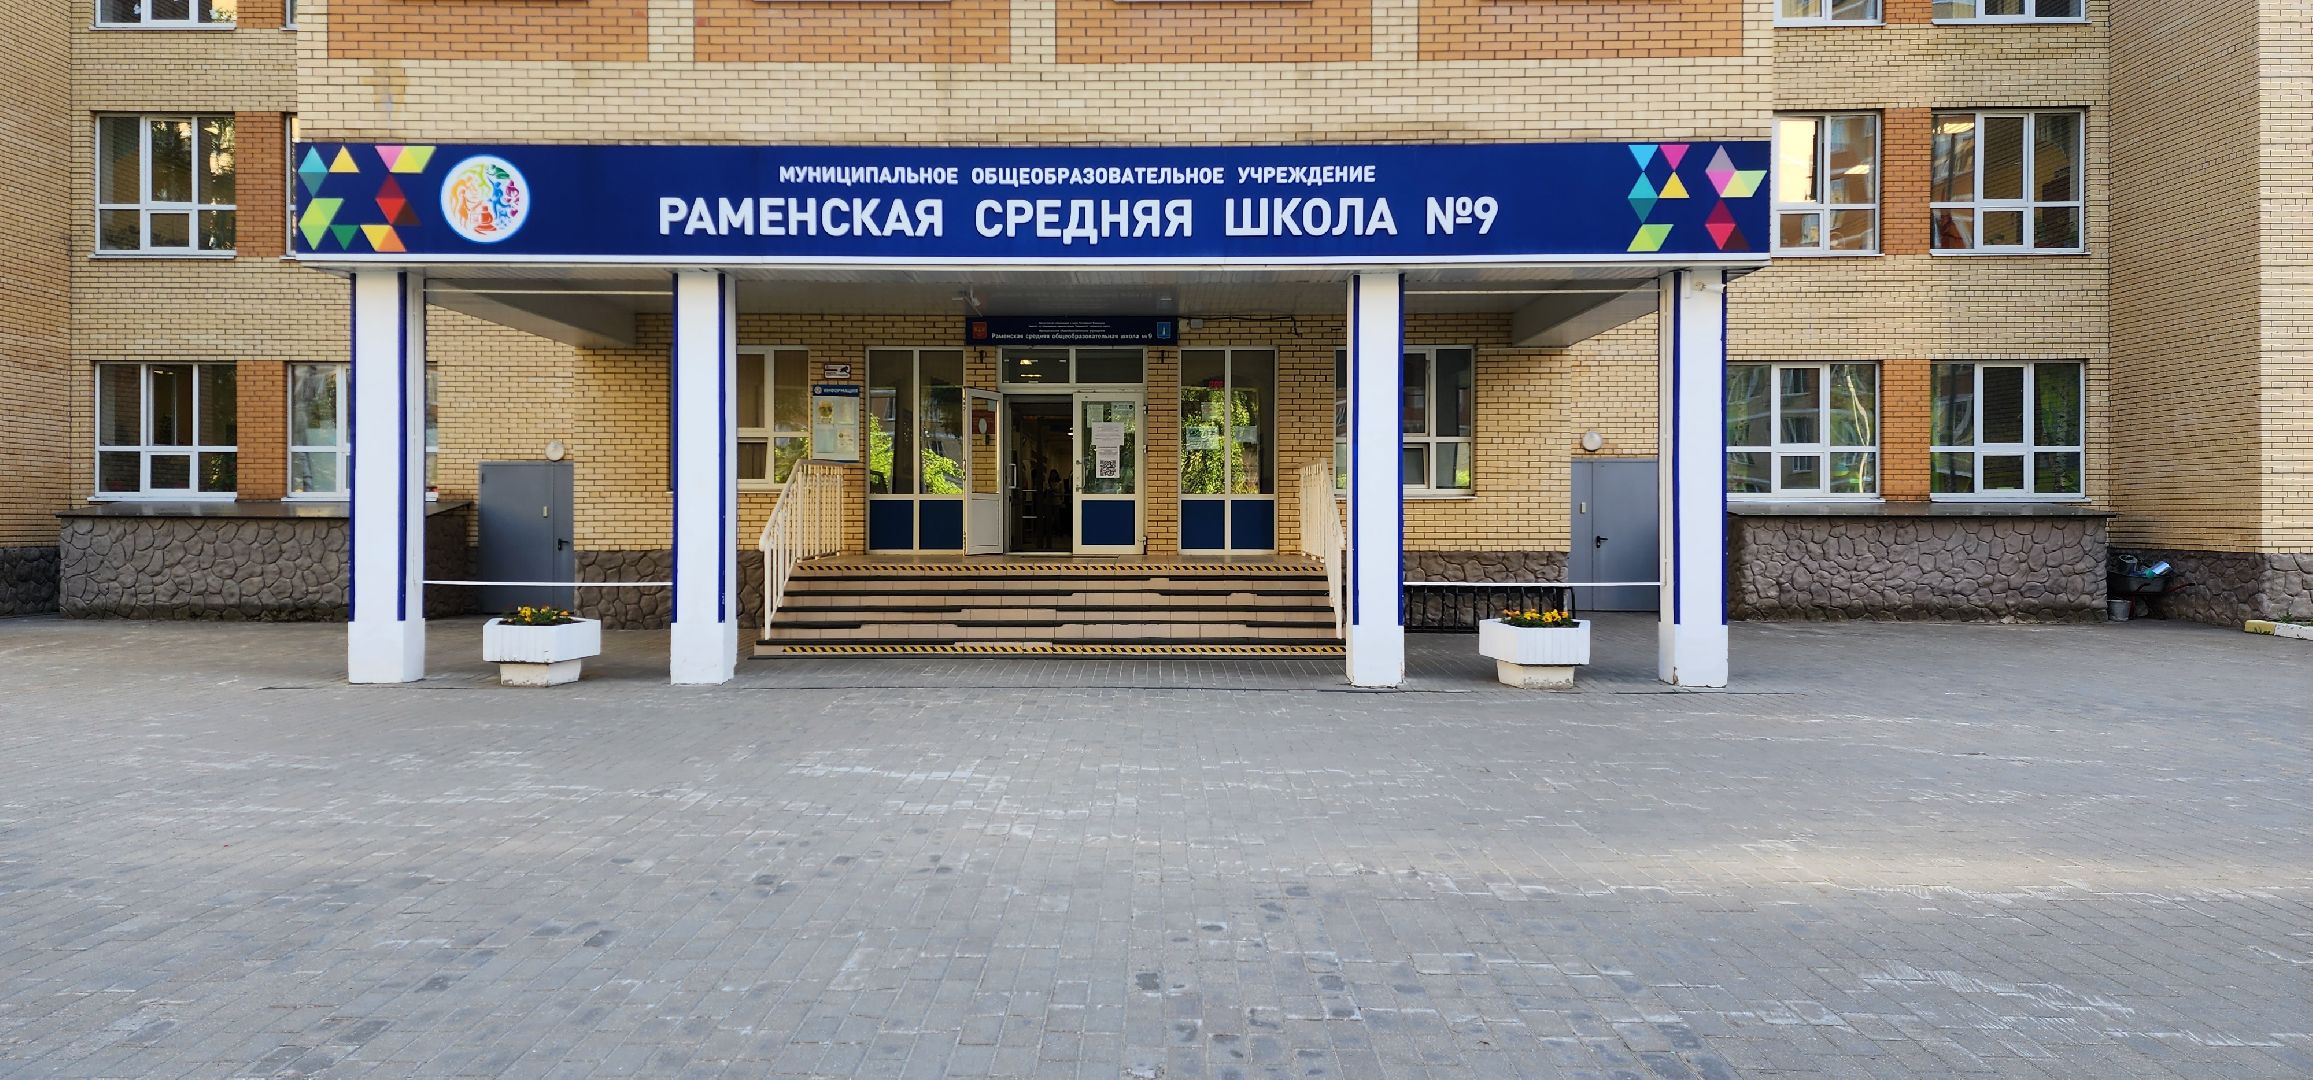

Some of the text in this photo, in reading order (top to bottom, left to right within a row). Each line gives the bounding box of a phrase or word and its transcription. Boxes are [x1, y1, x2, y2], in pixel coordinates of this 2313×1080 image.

[779, 165, 1376, 188] МУНИЦИПАЛЬНОЕ ОБЩЕОБРАЗОВАТЕЛЬНОЕ УЧРЕЖДЕНИЕ
[659, 196, 1499, 245] РАМЕНСКАЯ СРЕДНЯЯ ШКОЛА №9
